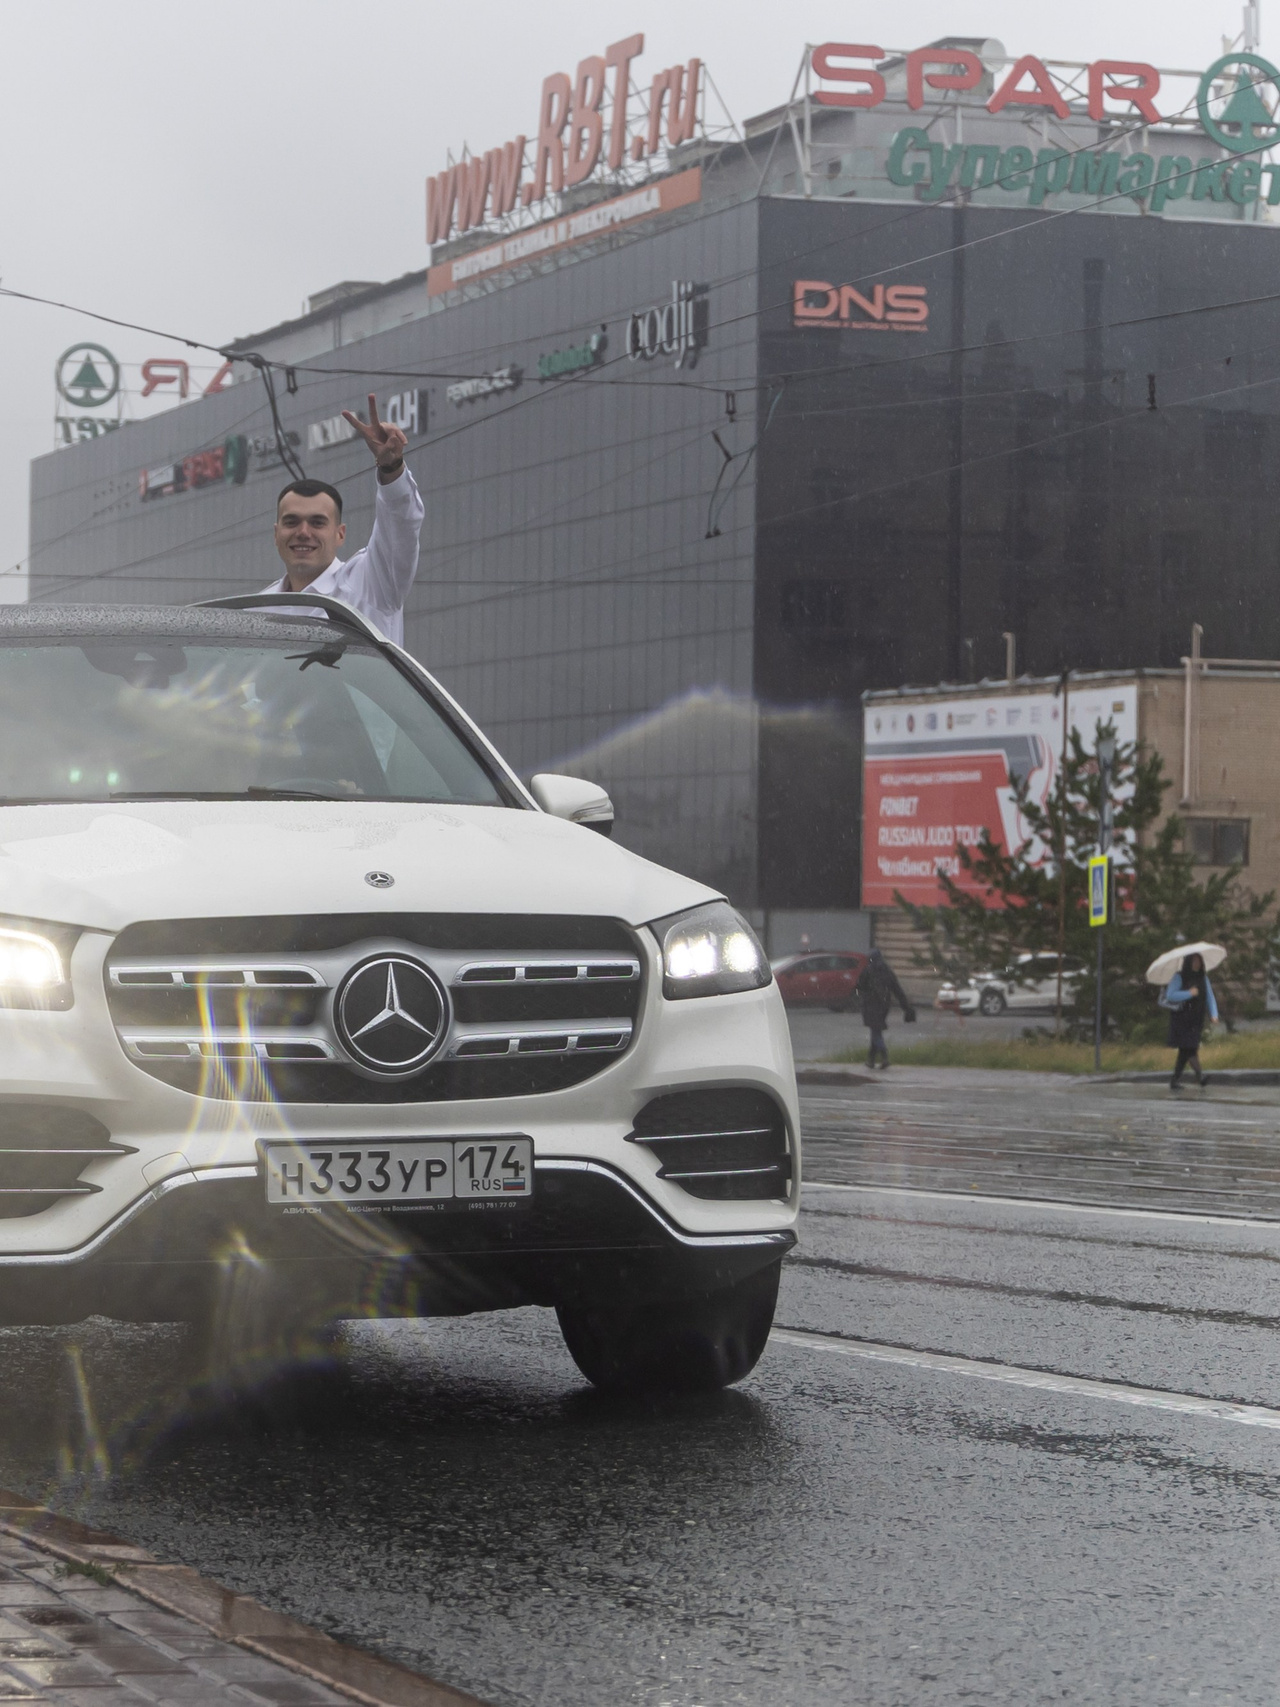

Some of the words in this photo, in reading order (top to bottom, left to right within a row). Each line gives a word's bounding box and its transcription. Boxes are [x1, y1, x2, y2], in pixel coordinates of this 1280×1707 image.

[812, 42, 1162, 124] SPAR
[426, 33, 702, 245] www.RBT.ru
[886, 126, 1280, 211] Супермаркет
[626, 280, 695, 370] oodji
[794, 280, 929, 322] DNS
[281, 1151, 447, 1196] Н333УР
[458, 1145, 521, 1179] 174
[471, 1179, 501, 1191] RUS
